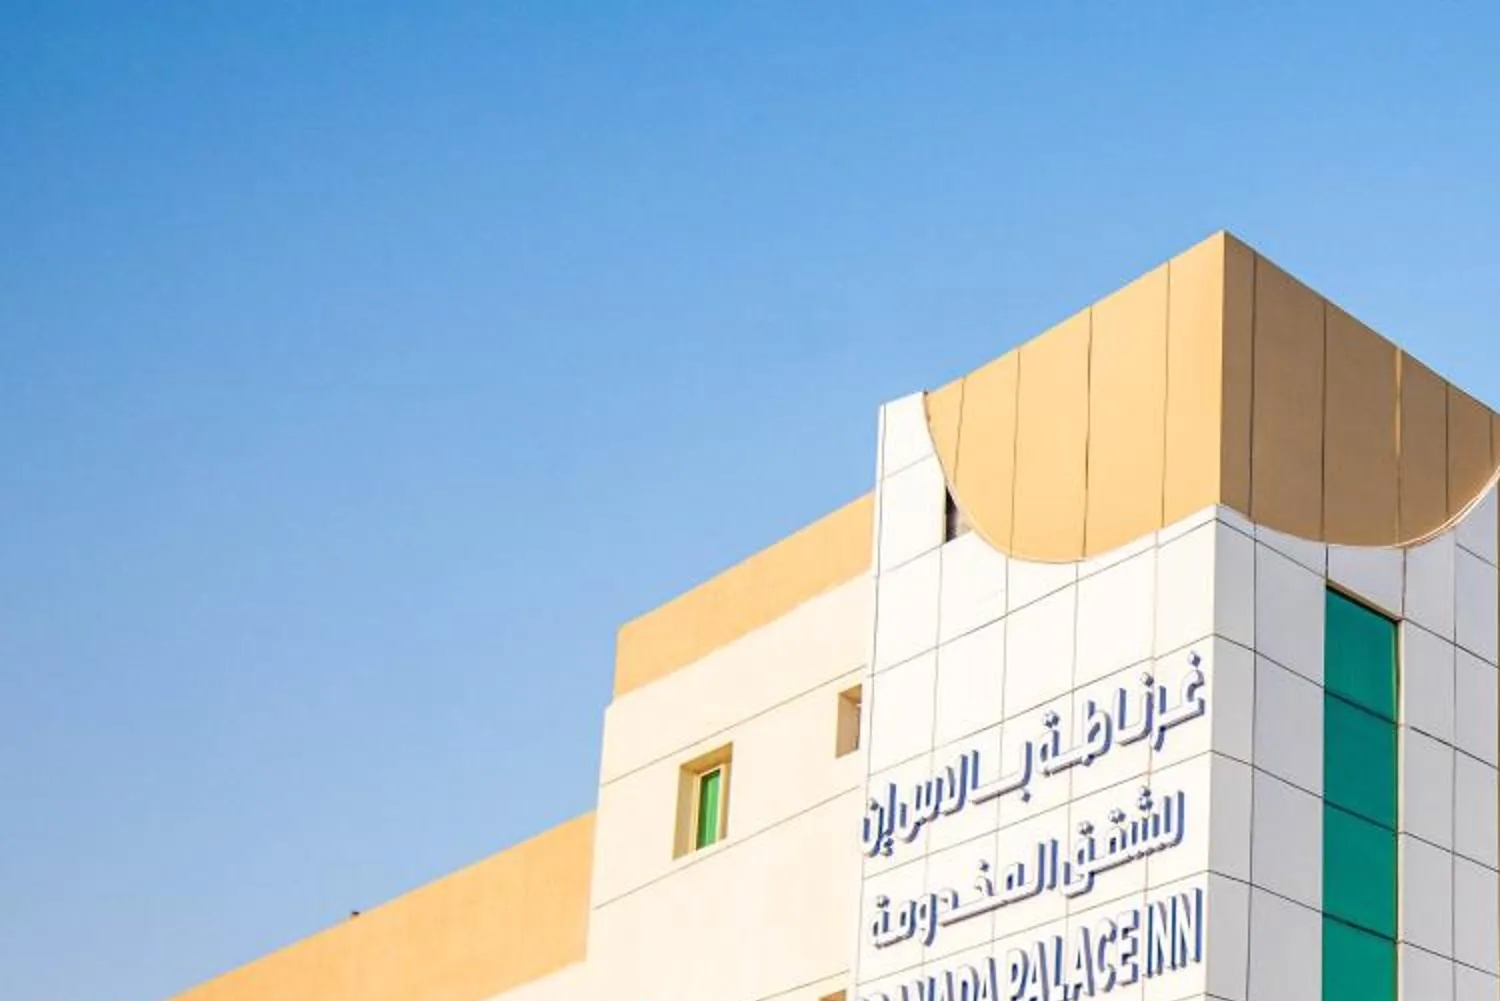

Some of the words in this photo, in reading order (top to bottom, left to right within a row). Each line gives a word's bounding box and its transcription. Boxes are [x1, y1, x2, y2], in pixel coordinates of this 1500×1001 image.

[1036, 650, 1205, 778] غرناطة
[869, 838, 1059, 950] المخدومة
[1062, 784, 1186, 899] الشقق
[1143, 886, 1204, 980] INN
